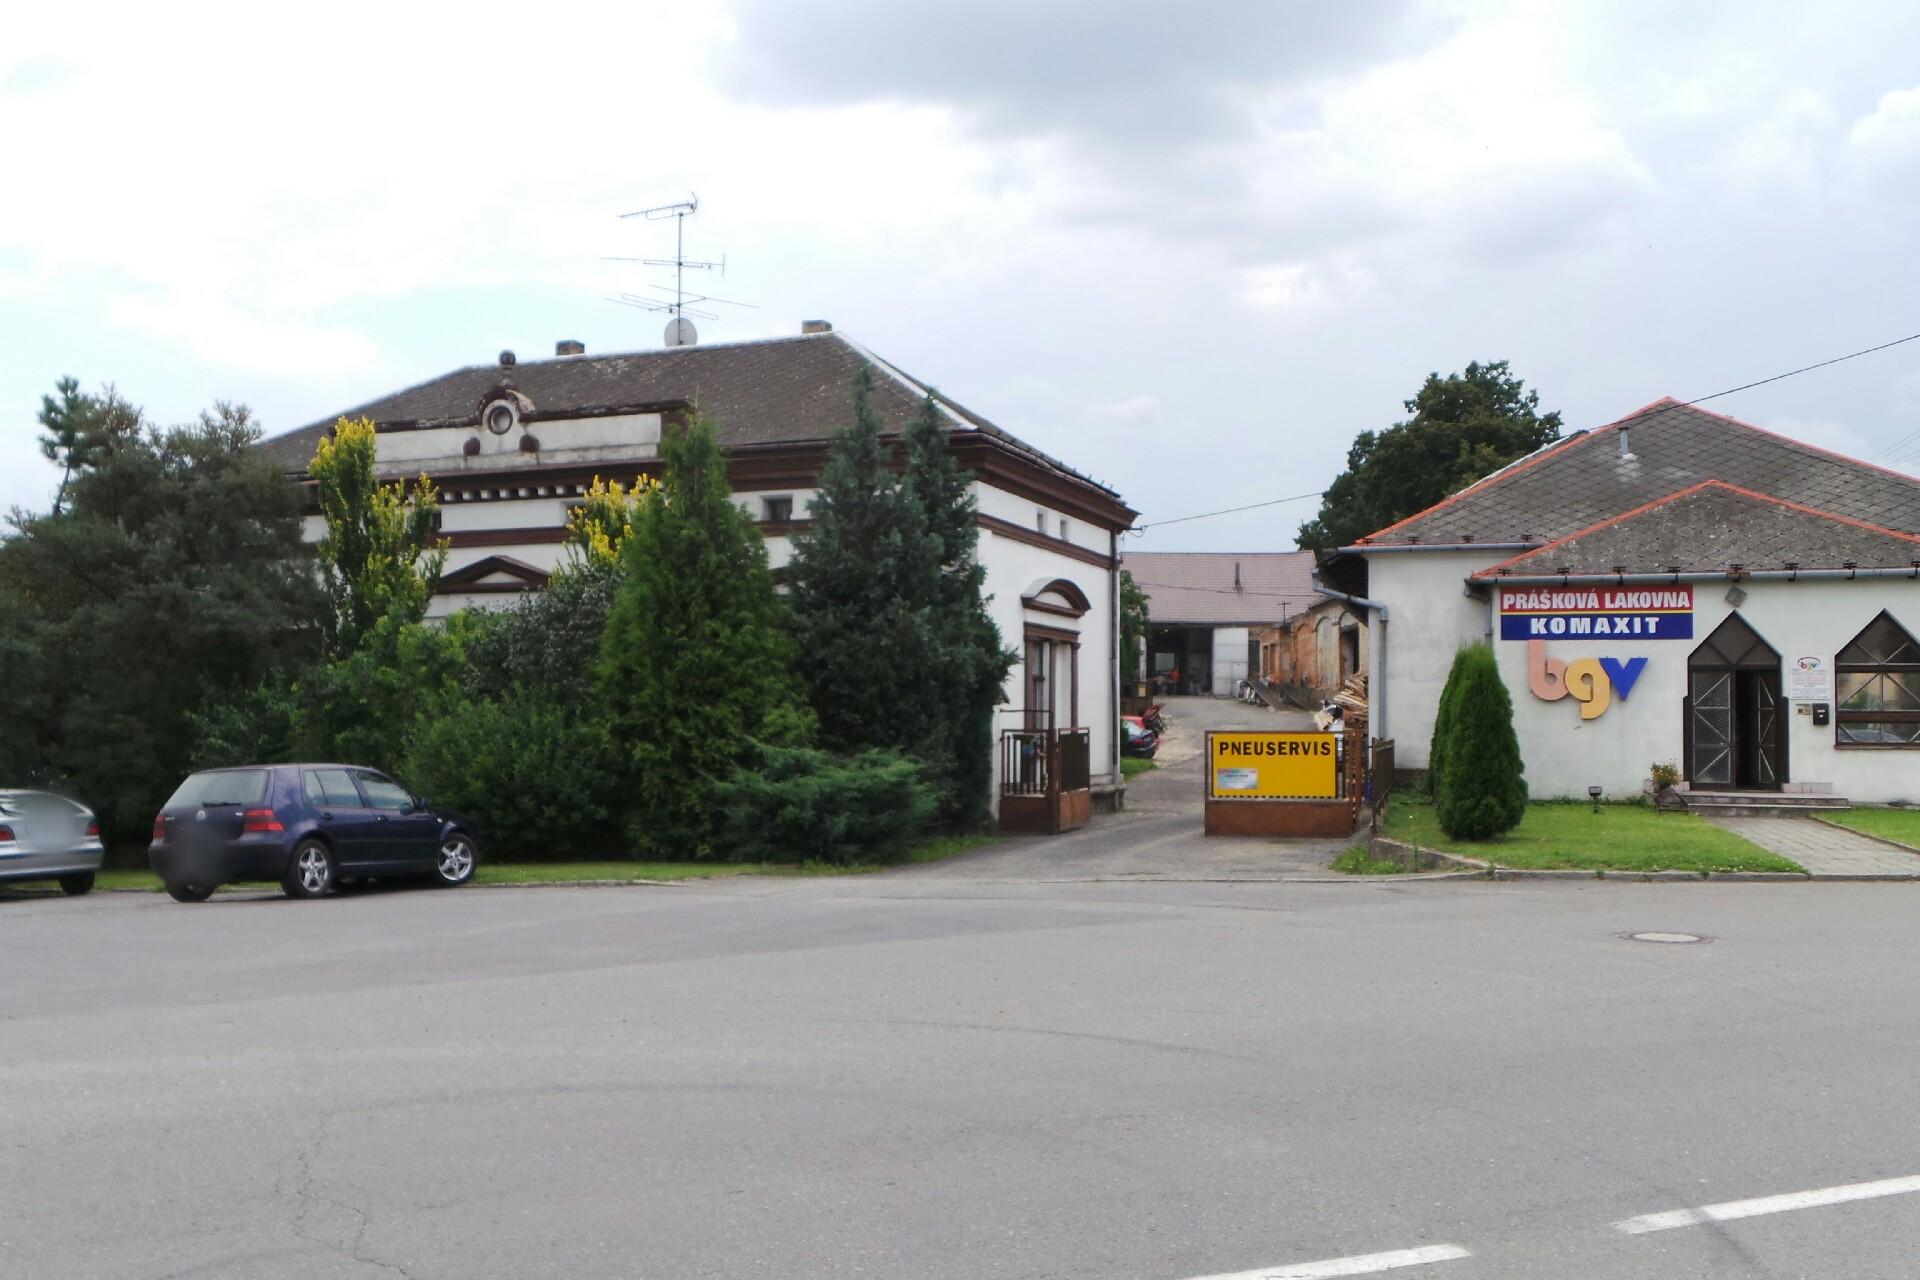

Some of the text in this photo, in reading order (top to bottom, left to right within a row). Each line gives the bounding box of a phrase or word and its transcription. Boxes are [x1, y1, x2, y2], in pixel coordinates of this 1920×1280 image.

[1503, 588, 1690, 610] PRÁŠKOVÁ LAKOVNA
[1530, 617, 1660, 634] KOMAXIT
[1528, 639, 1649, 720] bgv
[1219, 741, 1331, 756] PNEUSERVIS
